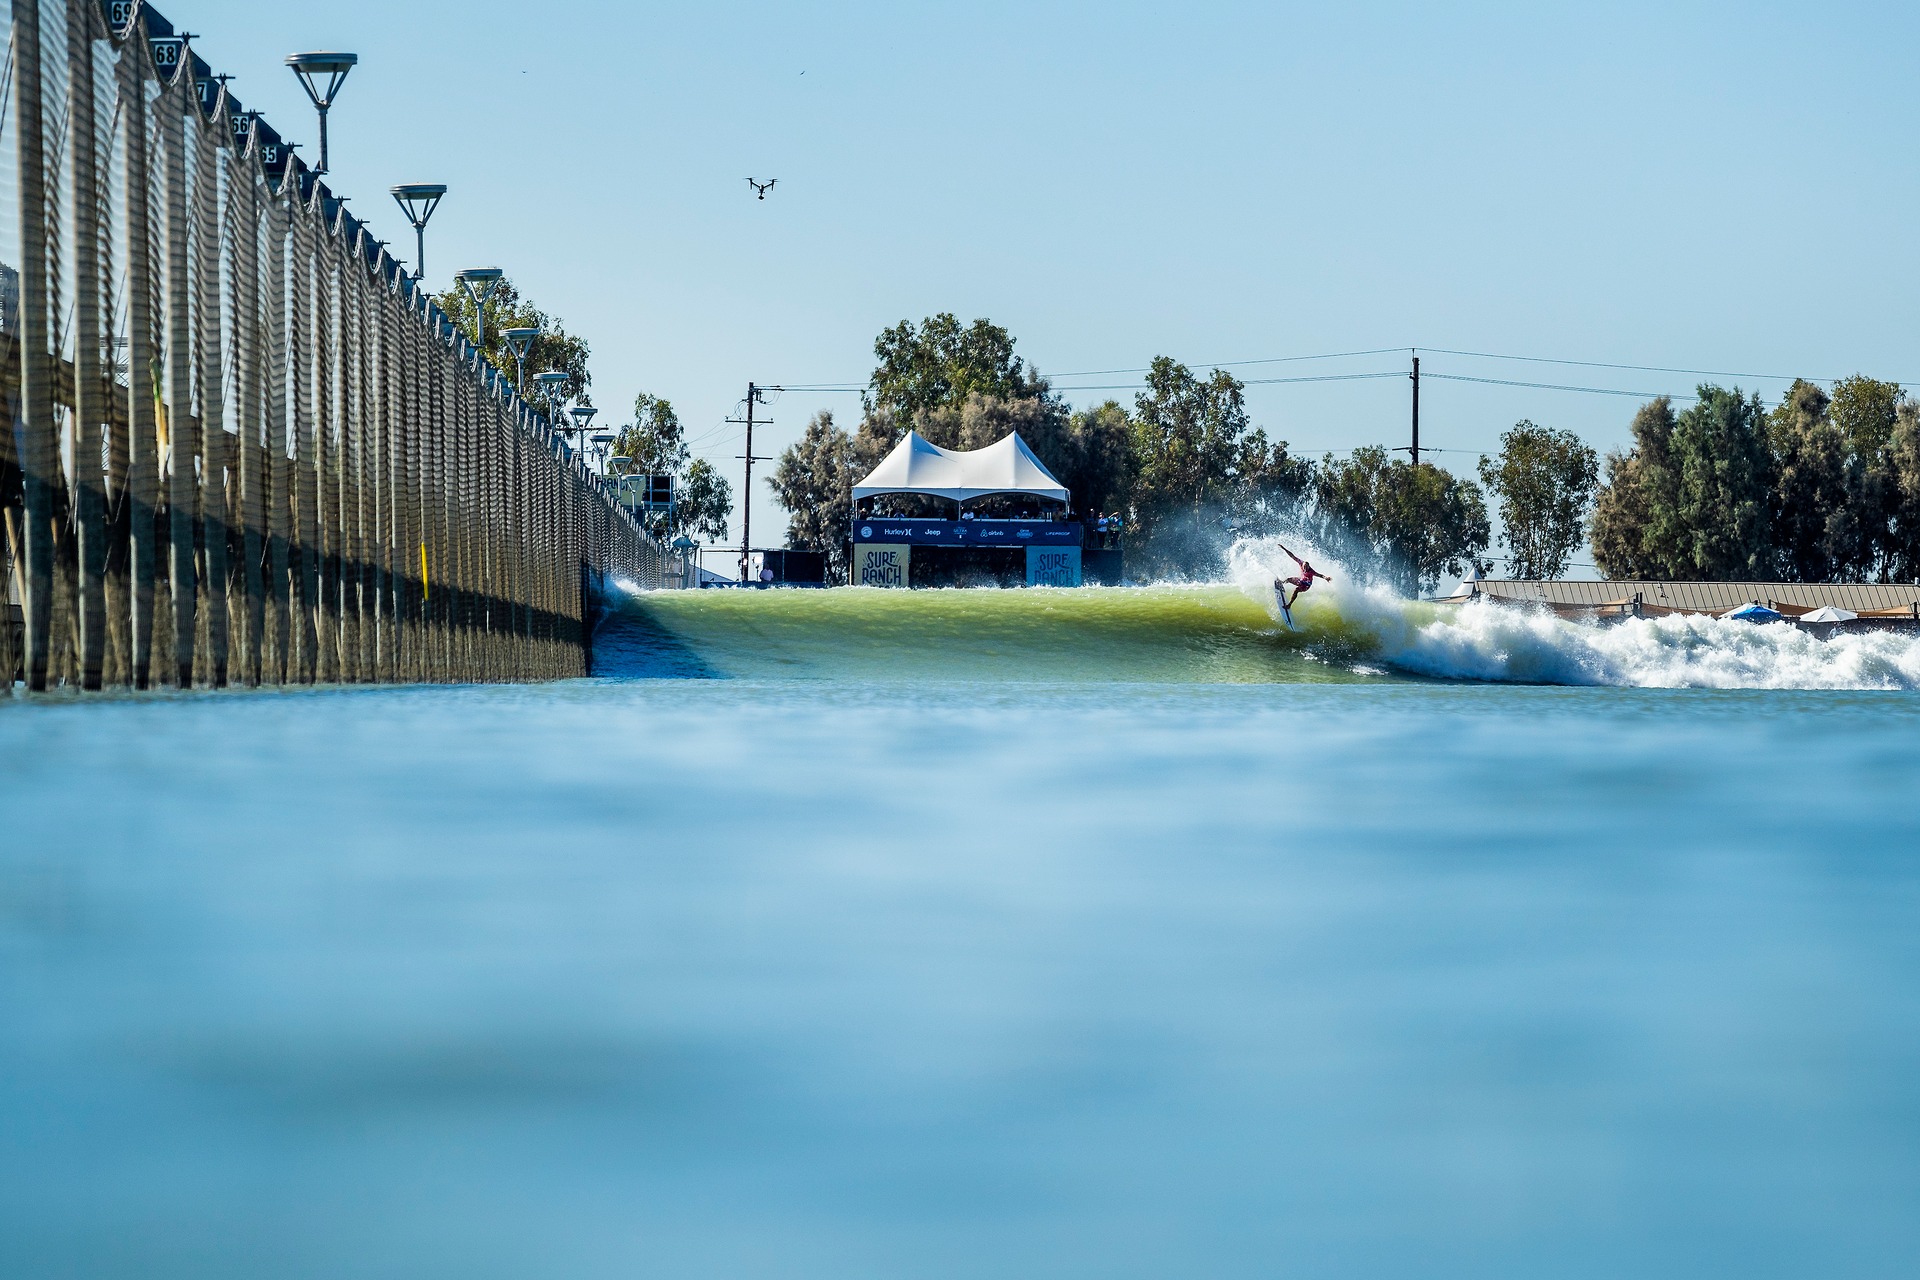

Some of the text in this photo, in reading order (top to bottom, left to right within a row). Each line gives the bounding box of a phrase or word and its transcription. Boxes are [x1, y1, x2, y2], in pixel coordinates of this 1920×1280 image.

[113, 3, 132, 22] 69
[156, 45, 176, 65] 68
[232, 117, 248, 133] 66
[262, 147, 276, 162] 65
[884, 528, 905, 536] Hurley
[924, 528, 941, 536] Jeep
[867, 551, 898, 569] SURF
[1039, 553, 1070, 571] SURF
[862, 565, 902, 585] RANCH
[1034, 567, 1074, 586] RANCH
